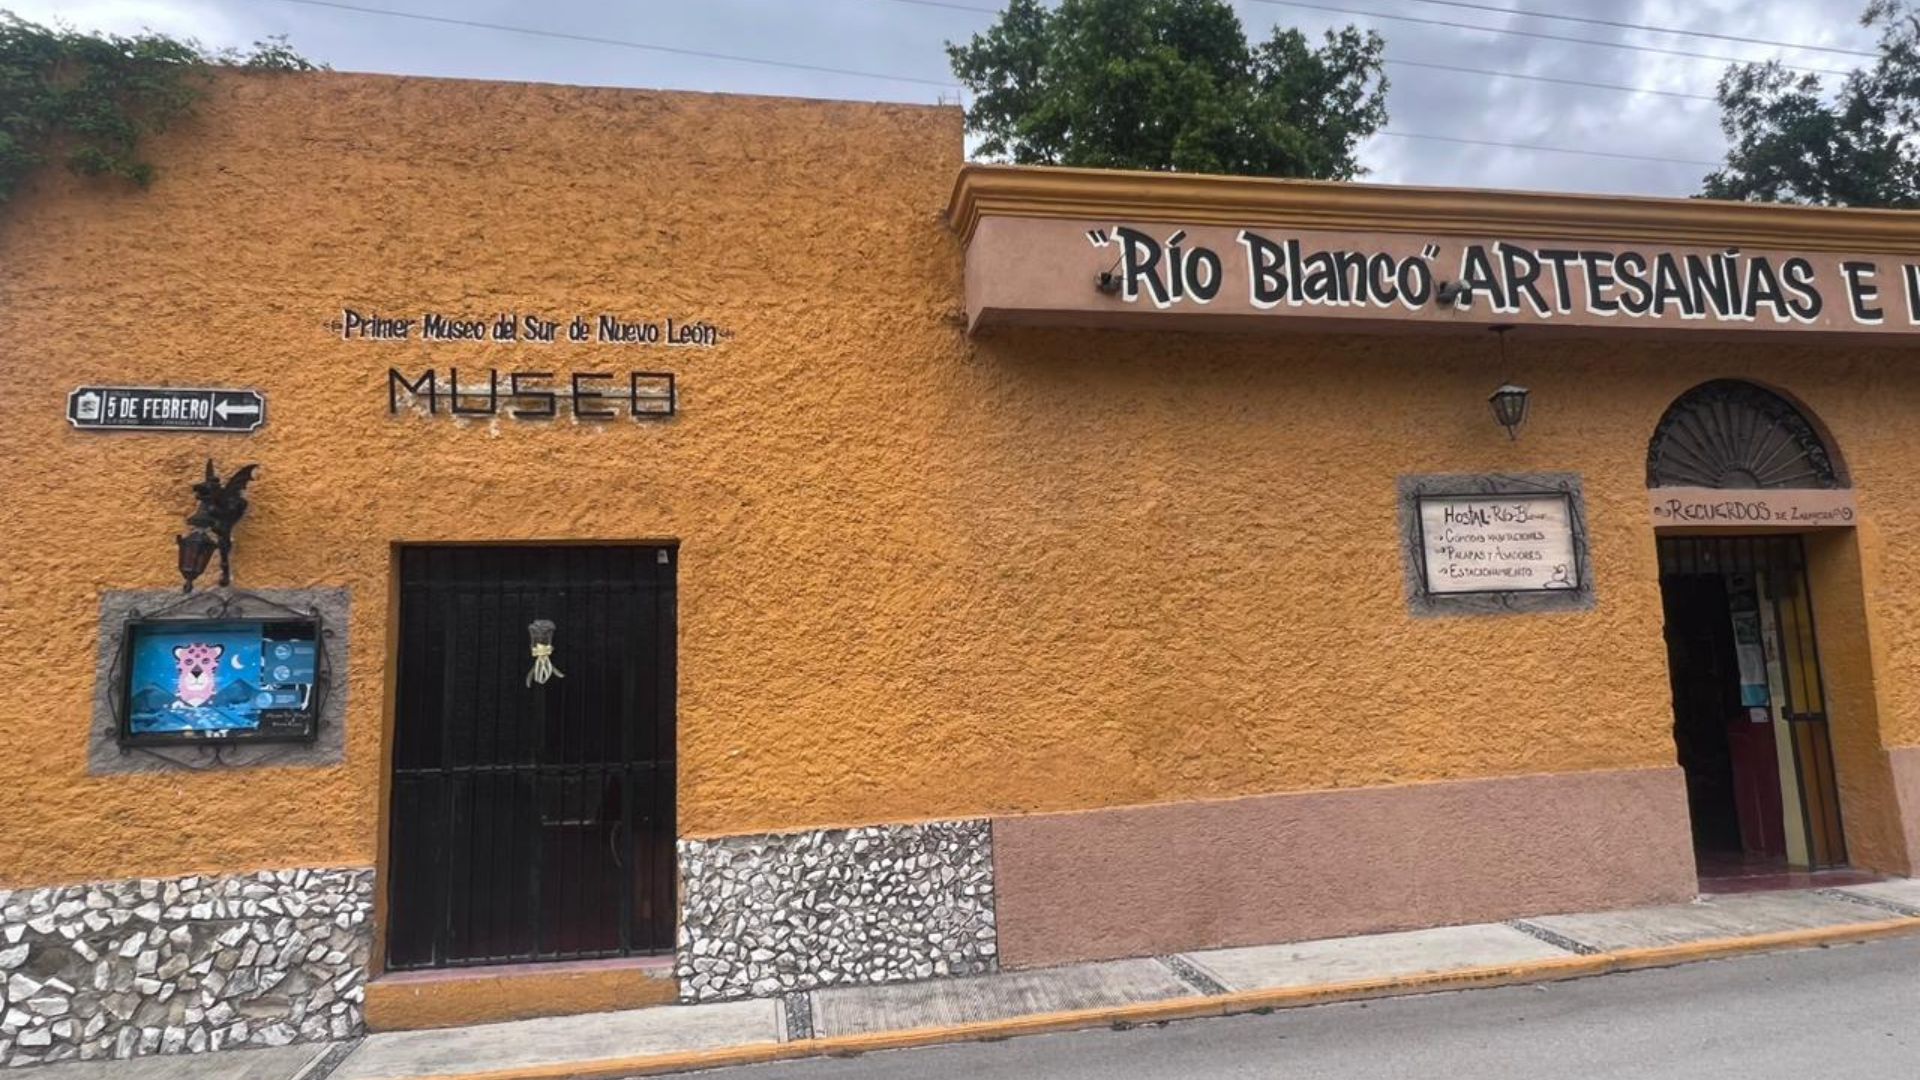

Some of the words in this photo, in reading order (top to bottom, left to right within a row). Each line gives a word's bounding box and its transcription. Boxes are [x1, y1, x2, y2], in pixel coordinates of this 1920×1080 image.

[1456, 238, 1823, 324] ARTESANÍAS
[1840, 261, 1884, 325] E
[342, 308, 415, 342] Primer
[422, 312, 486, 342] Museo
[491, 314, 518, 341] del
[521, 315, 560, 343] Sur
[568, 316, 590, 342] de
[598, 315, 660, 345] Nuevo
[665, 317, 718, 347] León
[107, 397, 116, 417] 5
[120, 398, 138, 418] DE
[143, 398, 209, 420] FEBRERO
[388, 366, 676, 420] MUSEO
[1667, 499, 1771, 522] RECUERDOS
